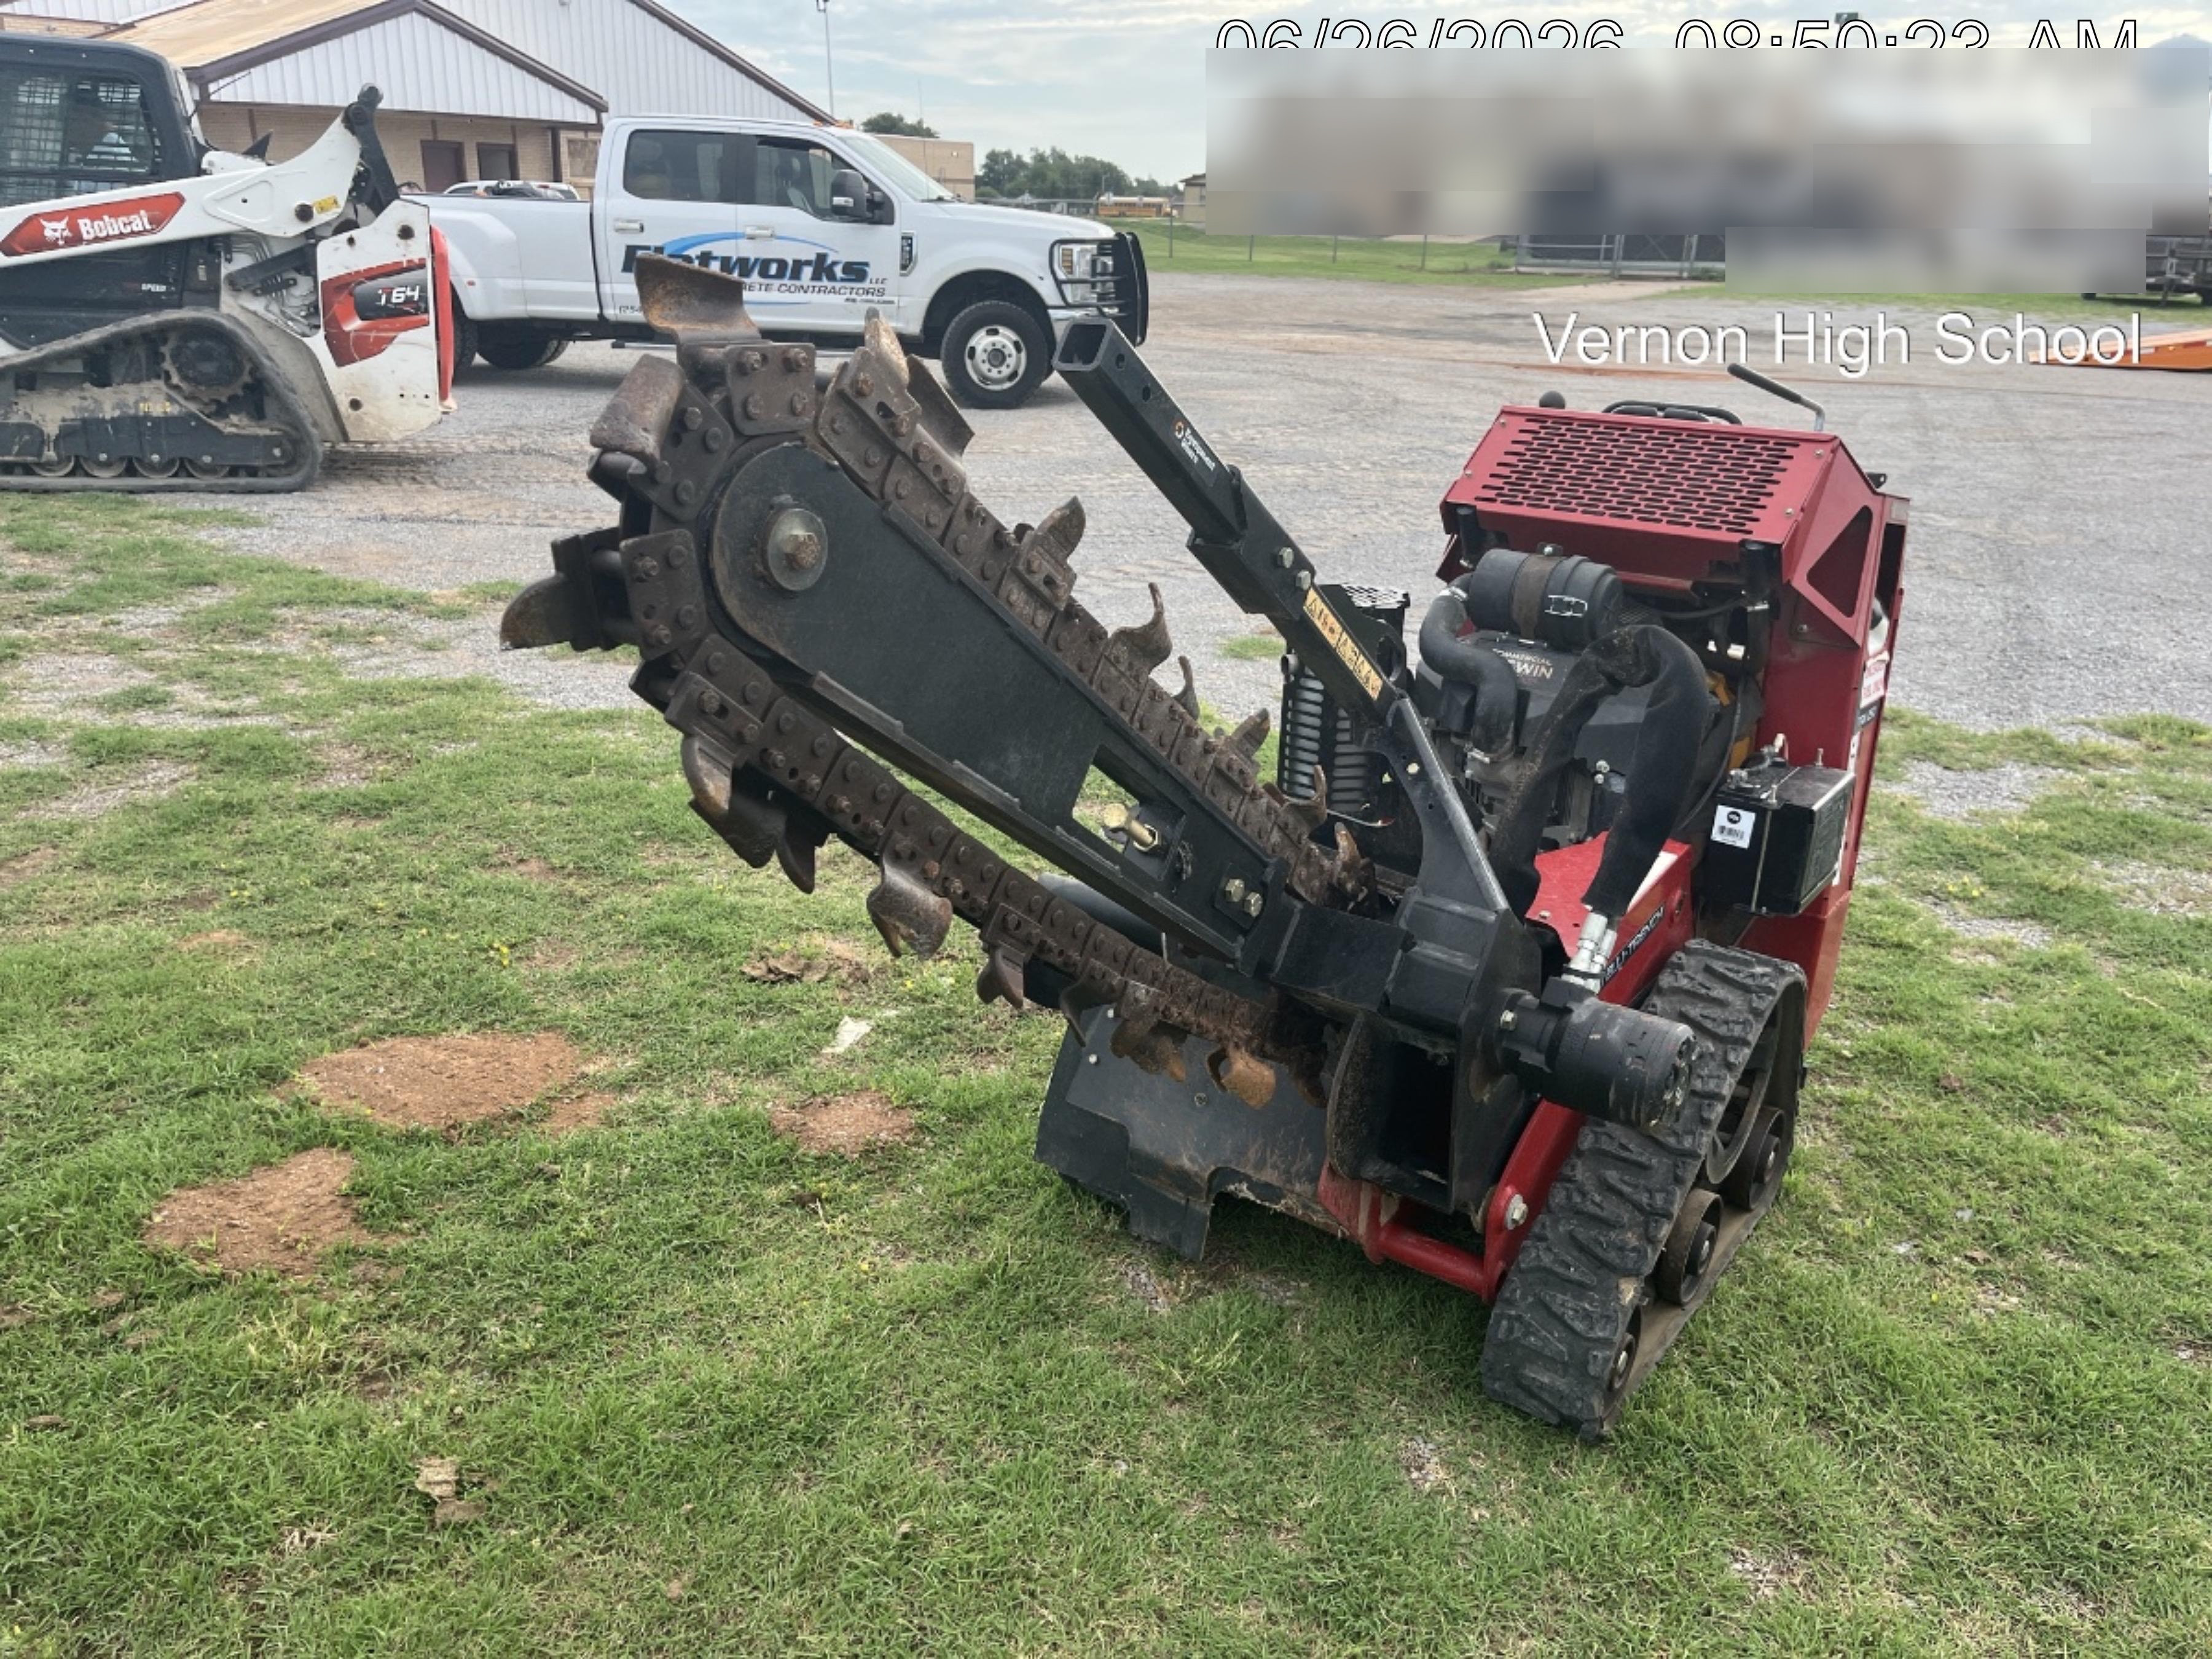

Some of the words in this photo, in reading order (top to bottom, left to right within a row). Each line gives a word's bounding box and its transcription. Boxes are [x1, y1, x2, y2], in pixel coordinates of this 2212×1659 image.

[77, 210, 152, 240] Bobcat
[621, 245, 869, 283] Ftworks
[377, 284, 420, 306] T64
[777, 283, 886, 297] CONTRACTORS
